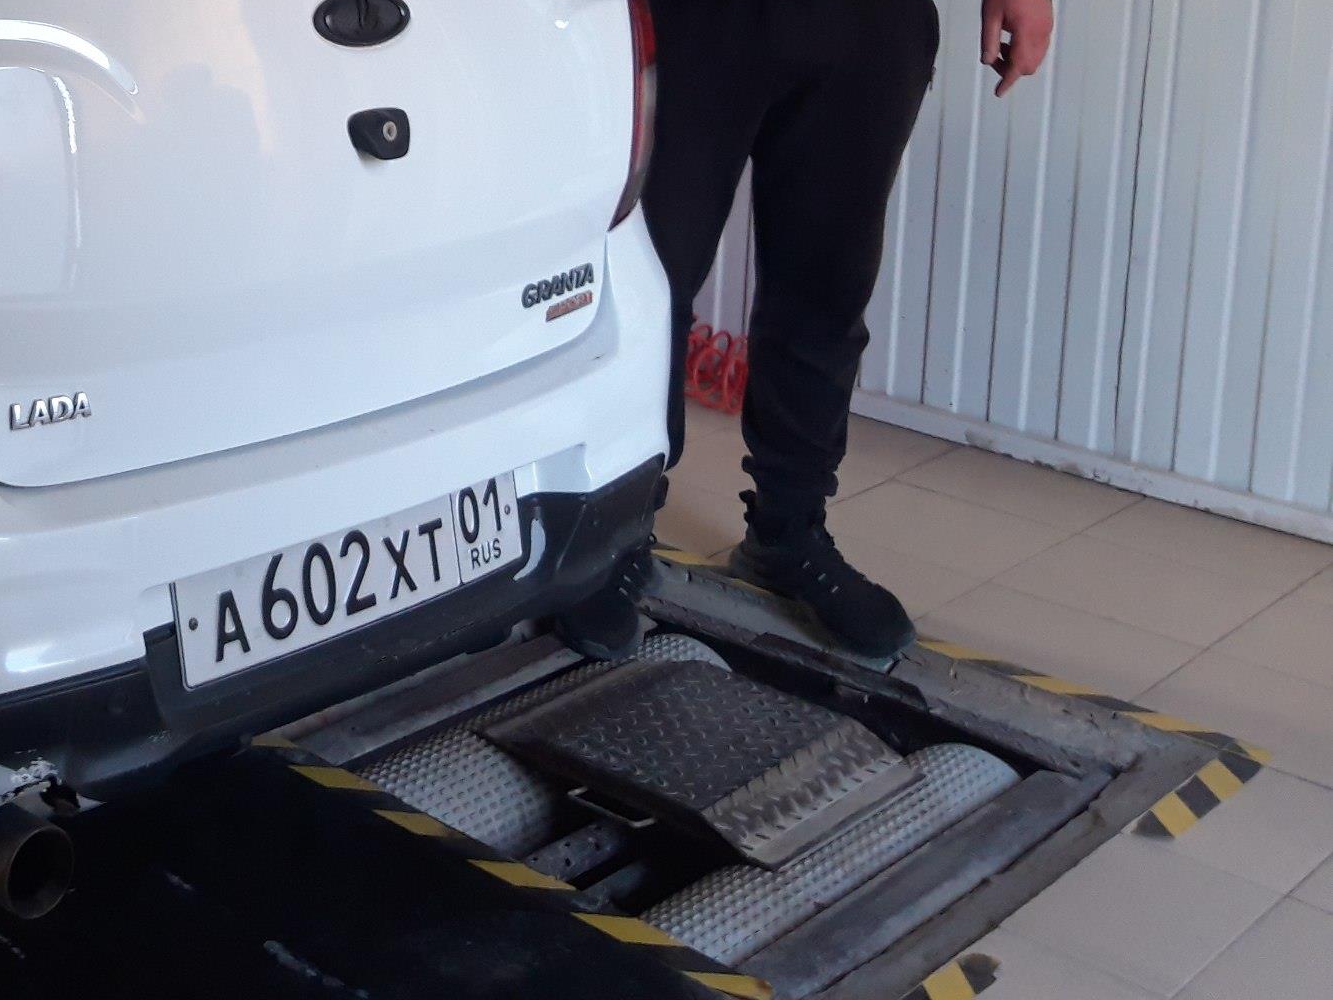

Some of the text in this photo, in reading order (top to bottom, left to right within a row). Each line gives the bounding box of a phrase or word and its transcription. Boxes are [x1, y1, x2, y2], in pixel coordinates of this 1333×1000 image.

[521, 262, 595, 309] GRANTA
[9, 391, 92, 431] LADA
[215, 477, 503, 662] А602ХТ 01
[470, 538, 502, 571] RUS
